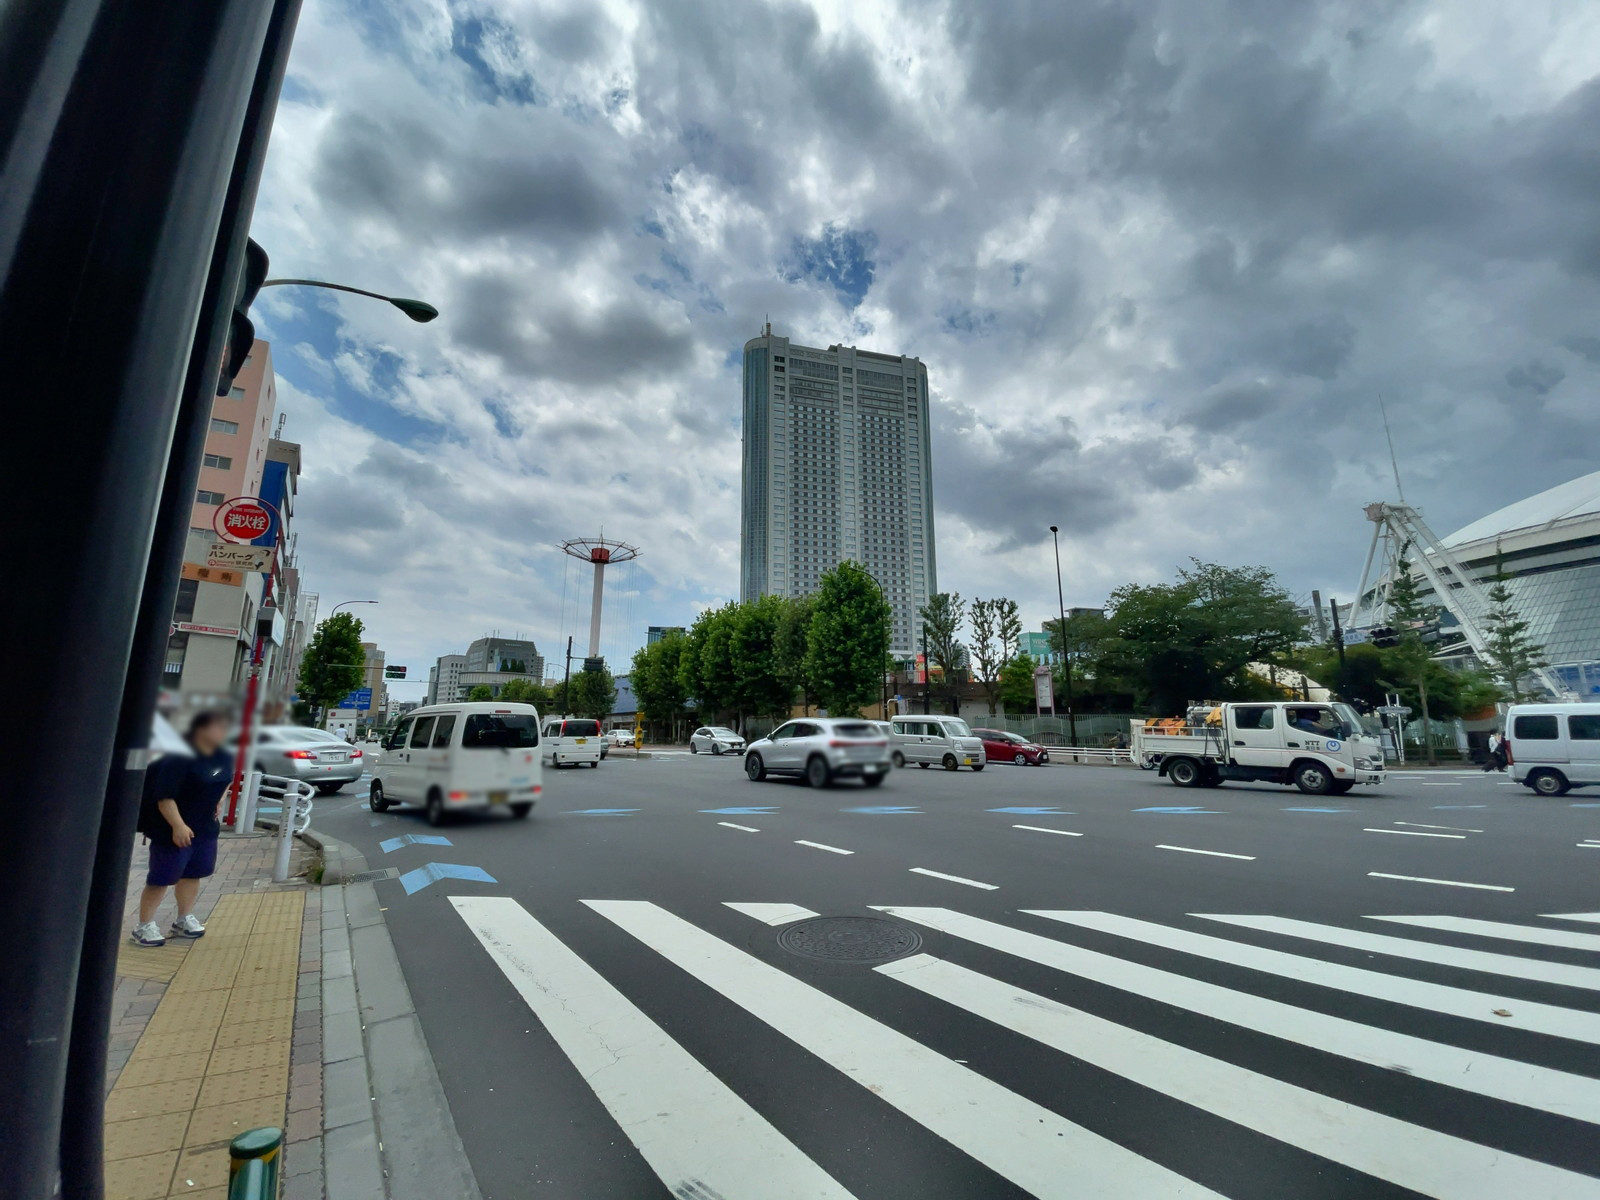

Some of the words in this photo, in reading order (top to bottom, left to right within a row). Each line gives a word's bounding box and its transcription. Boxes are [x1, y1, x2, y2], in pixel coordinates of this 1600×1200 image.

[227, 514, 266, 530] 消火栓
[209, 550, 254, 560] ハンバーグ
